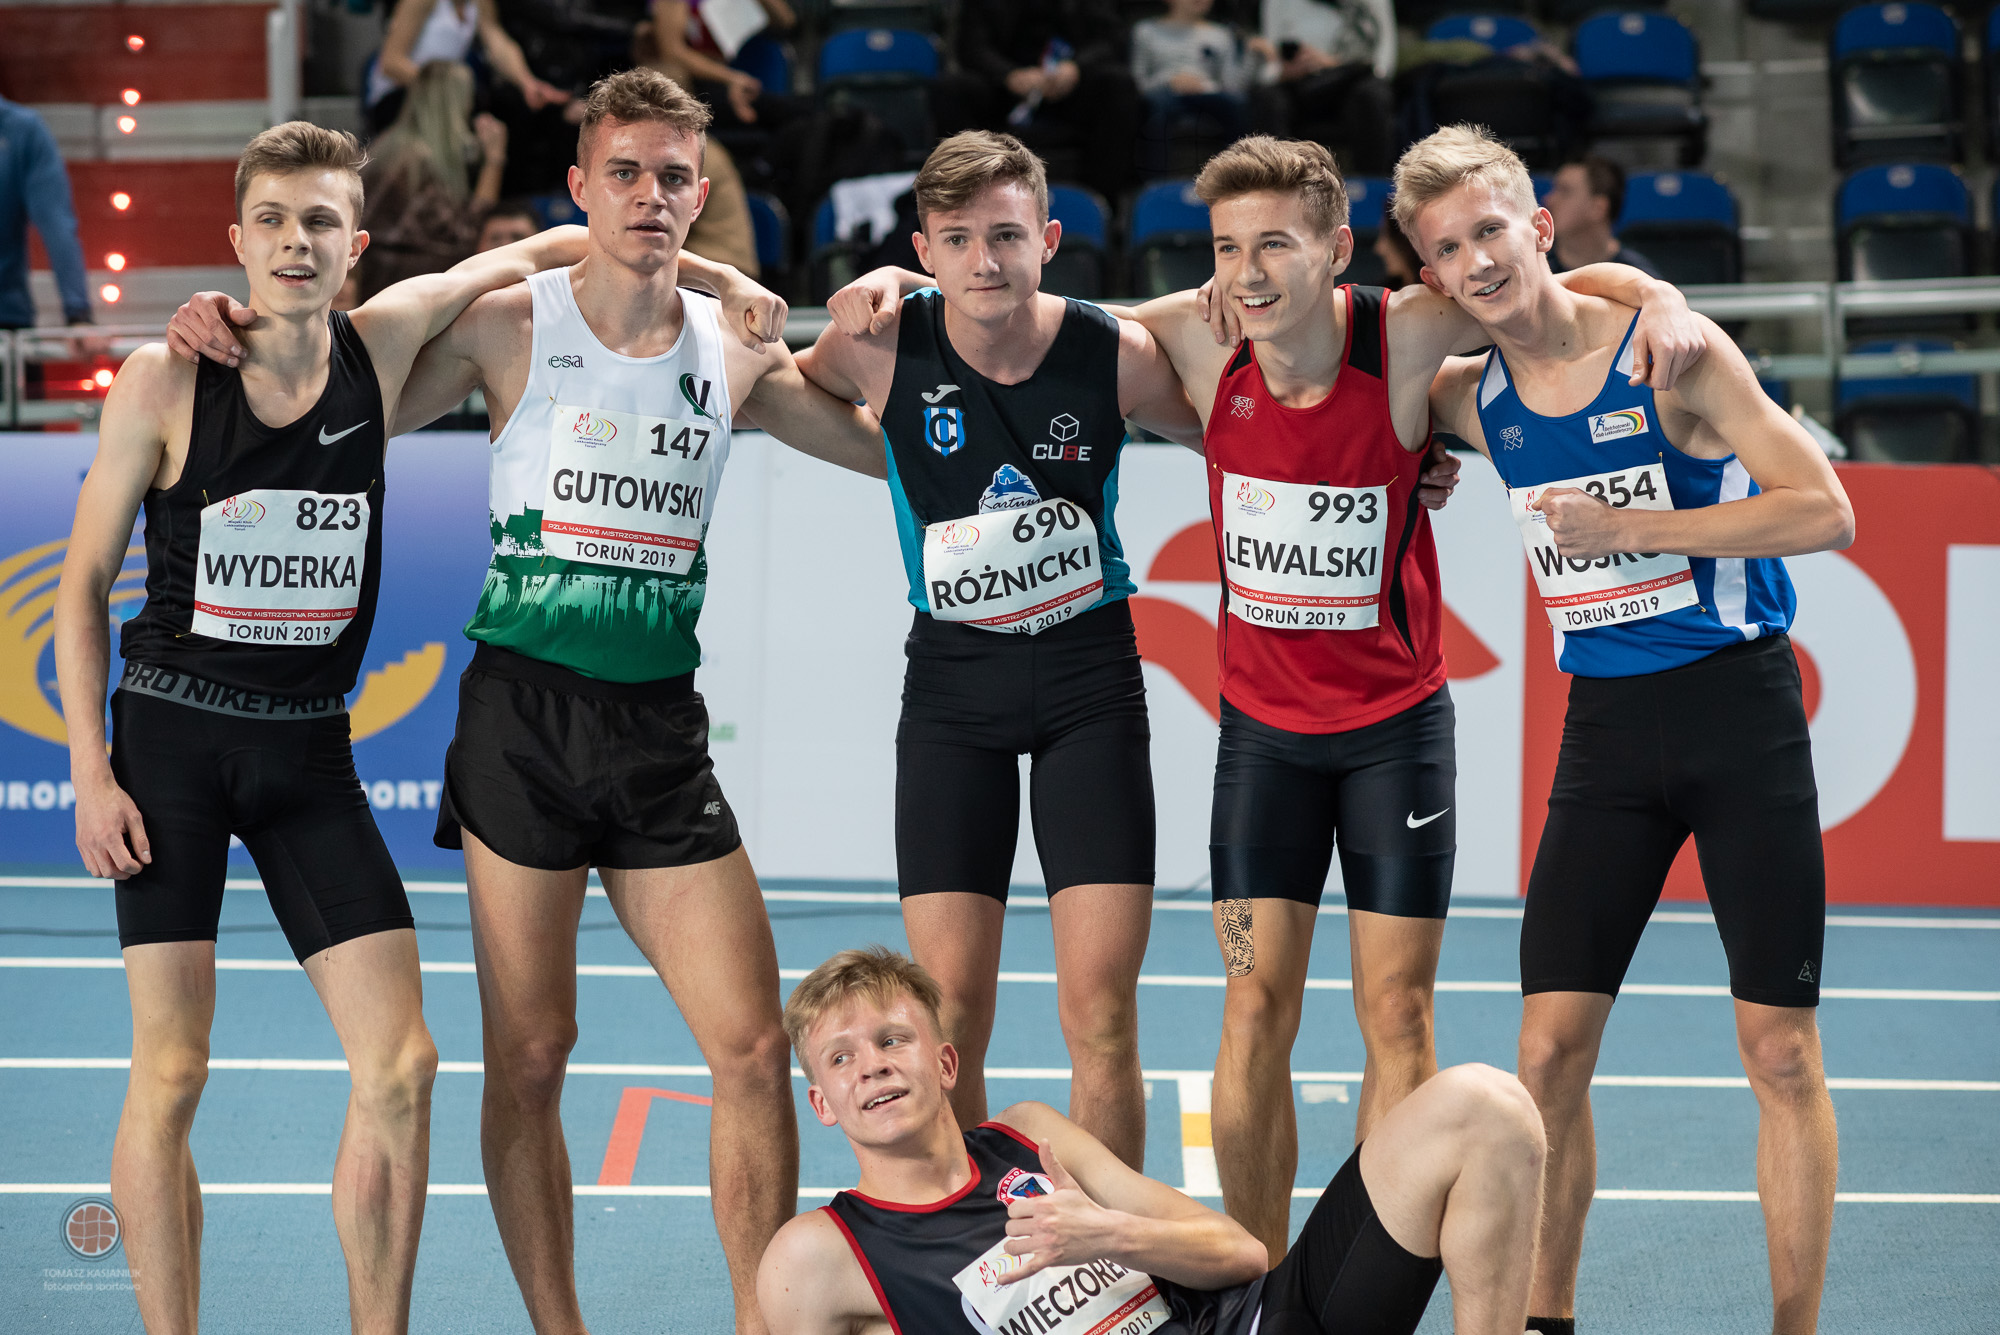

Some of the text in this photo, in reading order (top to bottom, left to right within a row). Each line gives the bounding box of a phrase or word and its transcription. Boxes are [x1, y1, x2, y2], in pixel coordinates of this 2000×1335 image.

[650, 423, 711, 461] 147
[1032, 443, 1092, 462] CUBE
[553, 468, 703, 520] GUTOWSKI
[1585, 471, 1658, 508] 354
[296, 497, 361, 531] 823
[1013, 501, 1080, 543] 690
[1308, 491, 1378, 524] 993
[548, 523, 568, 532] PZLA
[568, 526, 600, 536] HALOWE
[601, 530, 653, 542] MISTRZOSTWA
[654, 536, 676, 545] POLSKI
[677, 539, 686, 547] U18
[576, 541, 676, 568] TORUŃ 2019
[1226, 531, 1377, 578] LEWALSKI
[204, 553, 357, 588] WYDERKA
[931, 545, 1092, 610] RÓŻNICKI
[993, 605, 1045, 623] MISTRZOSTWA
[1045, 596, 1068, 609] POLSKI
[1069, 590, 1081, 599] U18
[1082, 584, 1096, 594] U20
[1240, 588, 1264, 600] HALOWE
[1265, 595, 1318, 604] MISTRZOSTWA
[1556, 596, 1578, 604] HALOWE
[1579, 590, 1628, 602] MISTRZOSTWA
[1627, 583, 1653, 593] POLSKI
[1655, 579, 1668, 587] U18
[1669, 574, 1684, 583] U20
[201, 604, 219, 614] PZLA
[220, 609, 252, 618] HALOWE
[1036, 606, 1072, 628] 2019
[1245, 603, 1346, 626] TORUŃ 2019
[1565, 596, 1659, 626] TORUŃ 2019
[228, 622, 331, 641] TORUŃ 2019
[122, 663, 181, 694] PRO
[181, 678, 262, 713] NIKE
[1120, 1300, 1138, 1316] POLSKI
[1121, 1311, 1153, 1335] 2019
